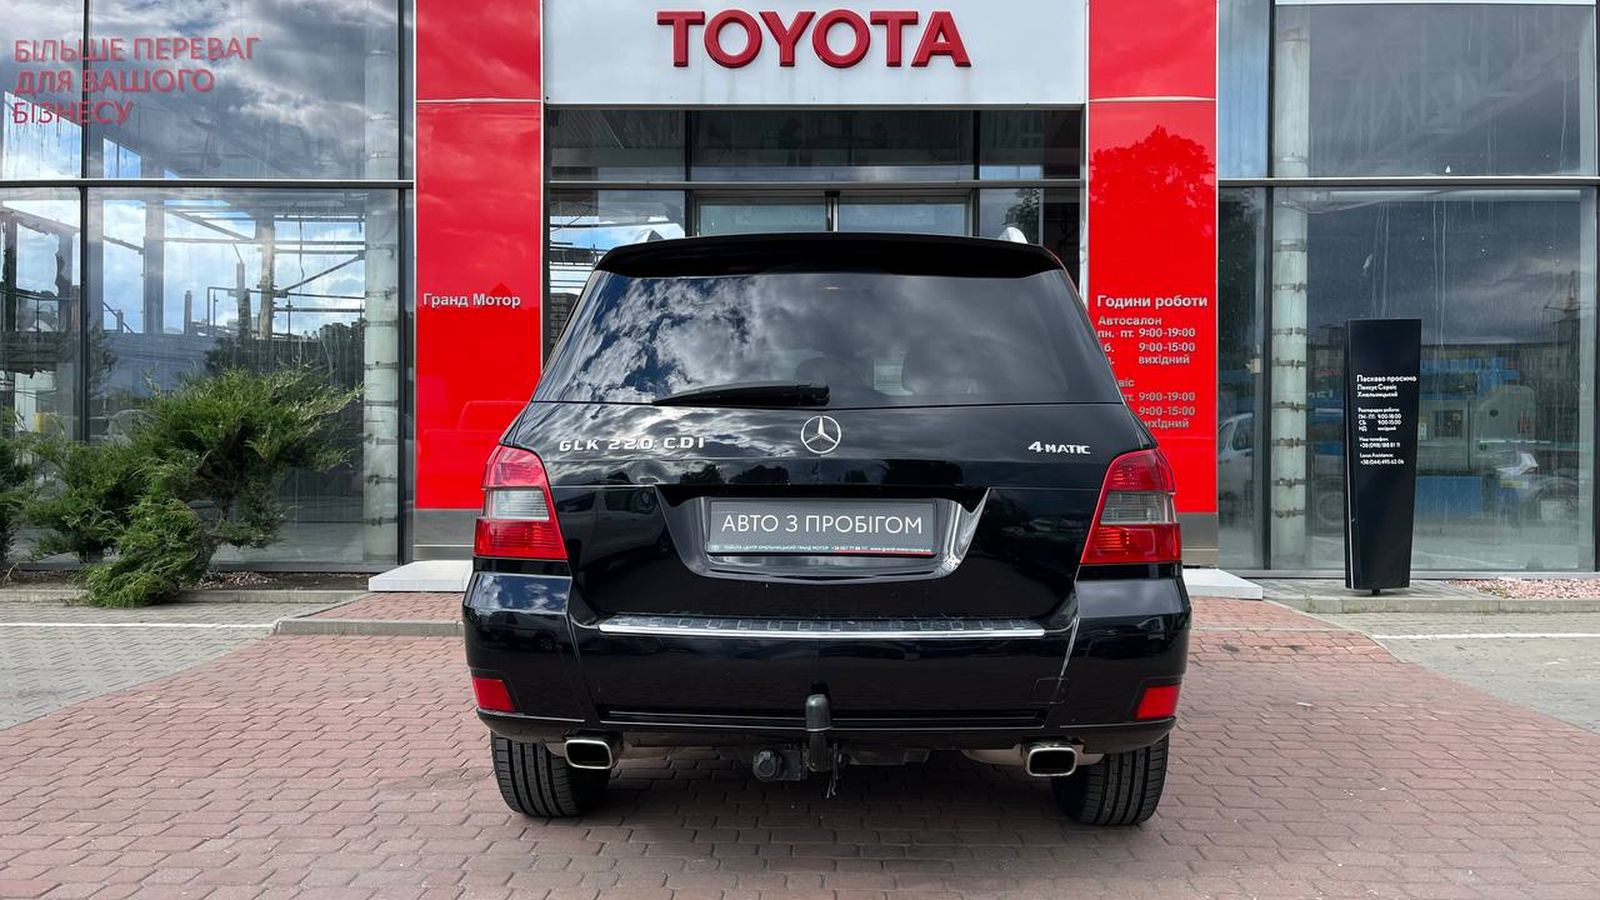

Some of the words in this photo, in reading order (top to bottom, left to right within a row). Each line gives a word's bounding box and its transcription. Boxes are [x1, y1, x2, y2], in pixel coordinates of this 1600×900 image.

[657, 9, 972, 69] TOYOTA
[14, 38, 126, 62] БІЛЬШЕ
[134, 37, 261, 61] ПЕРЕВАГ
[14, 69, 72, 97] ДЛЯ
[82, 69, 215, 93] ВАШОГО
[13, 100, 133, 125] БІЗНЕСУ
[423, 292, 469, 308] Гранд
[473, 292, 521, 309] Мотор
[1097, 295, 1151, 309] Години
[1155, 294, 1208, 309] роботи
[1097, 316, 1162, 326] Автосалон
[1138, 328, 1196, 338] 9:00-19:00
[1138, 343, 1196, 352] 9:00-15:00
[1138, 354, 1190, 366] вихідний
[1138, 391, 1196, 401] 9:00-19:00
[1143, 418, 1189, 429] ихідний
[559, 438, 600, 451] GLK
[607, 438, 654, 450] 220
[663, 436, 705, 449] CDI
[1028, 440, 1091, 455] 4MATIC
[721, 514, 779, 533] АВТО
[785, 514, 798, 533] З
[805, 515, 923, 534] ПРОБІГОМ
